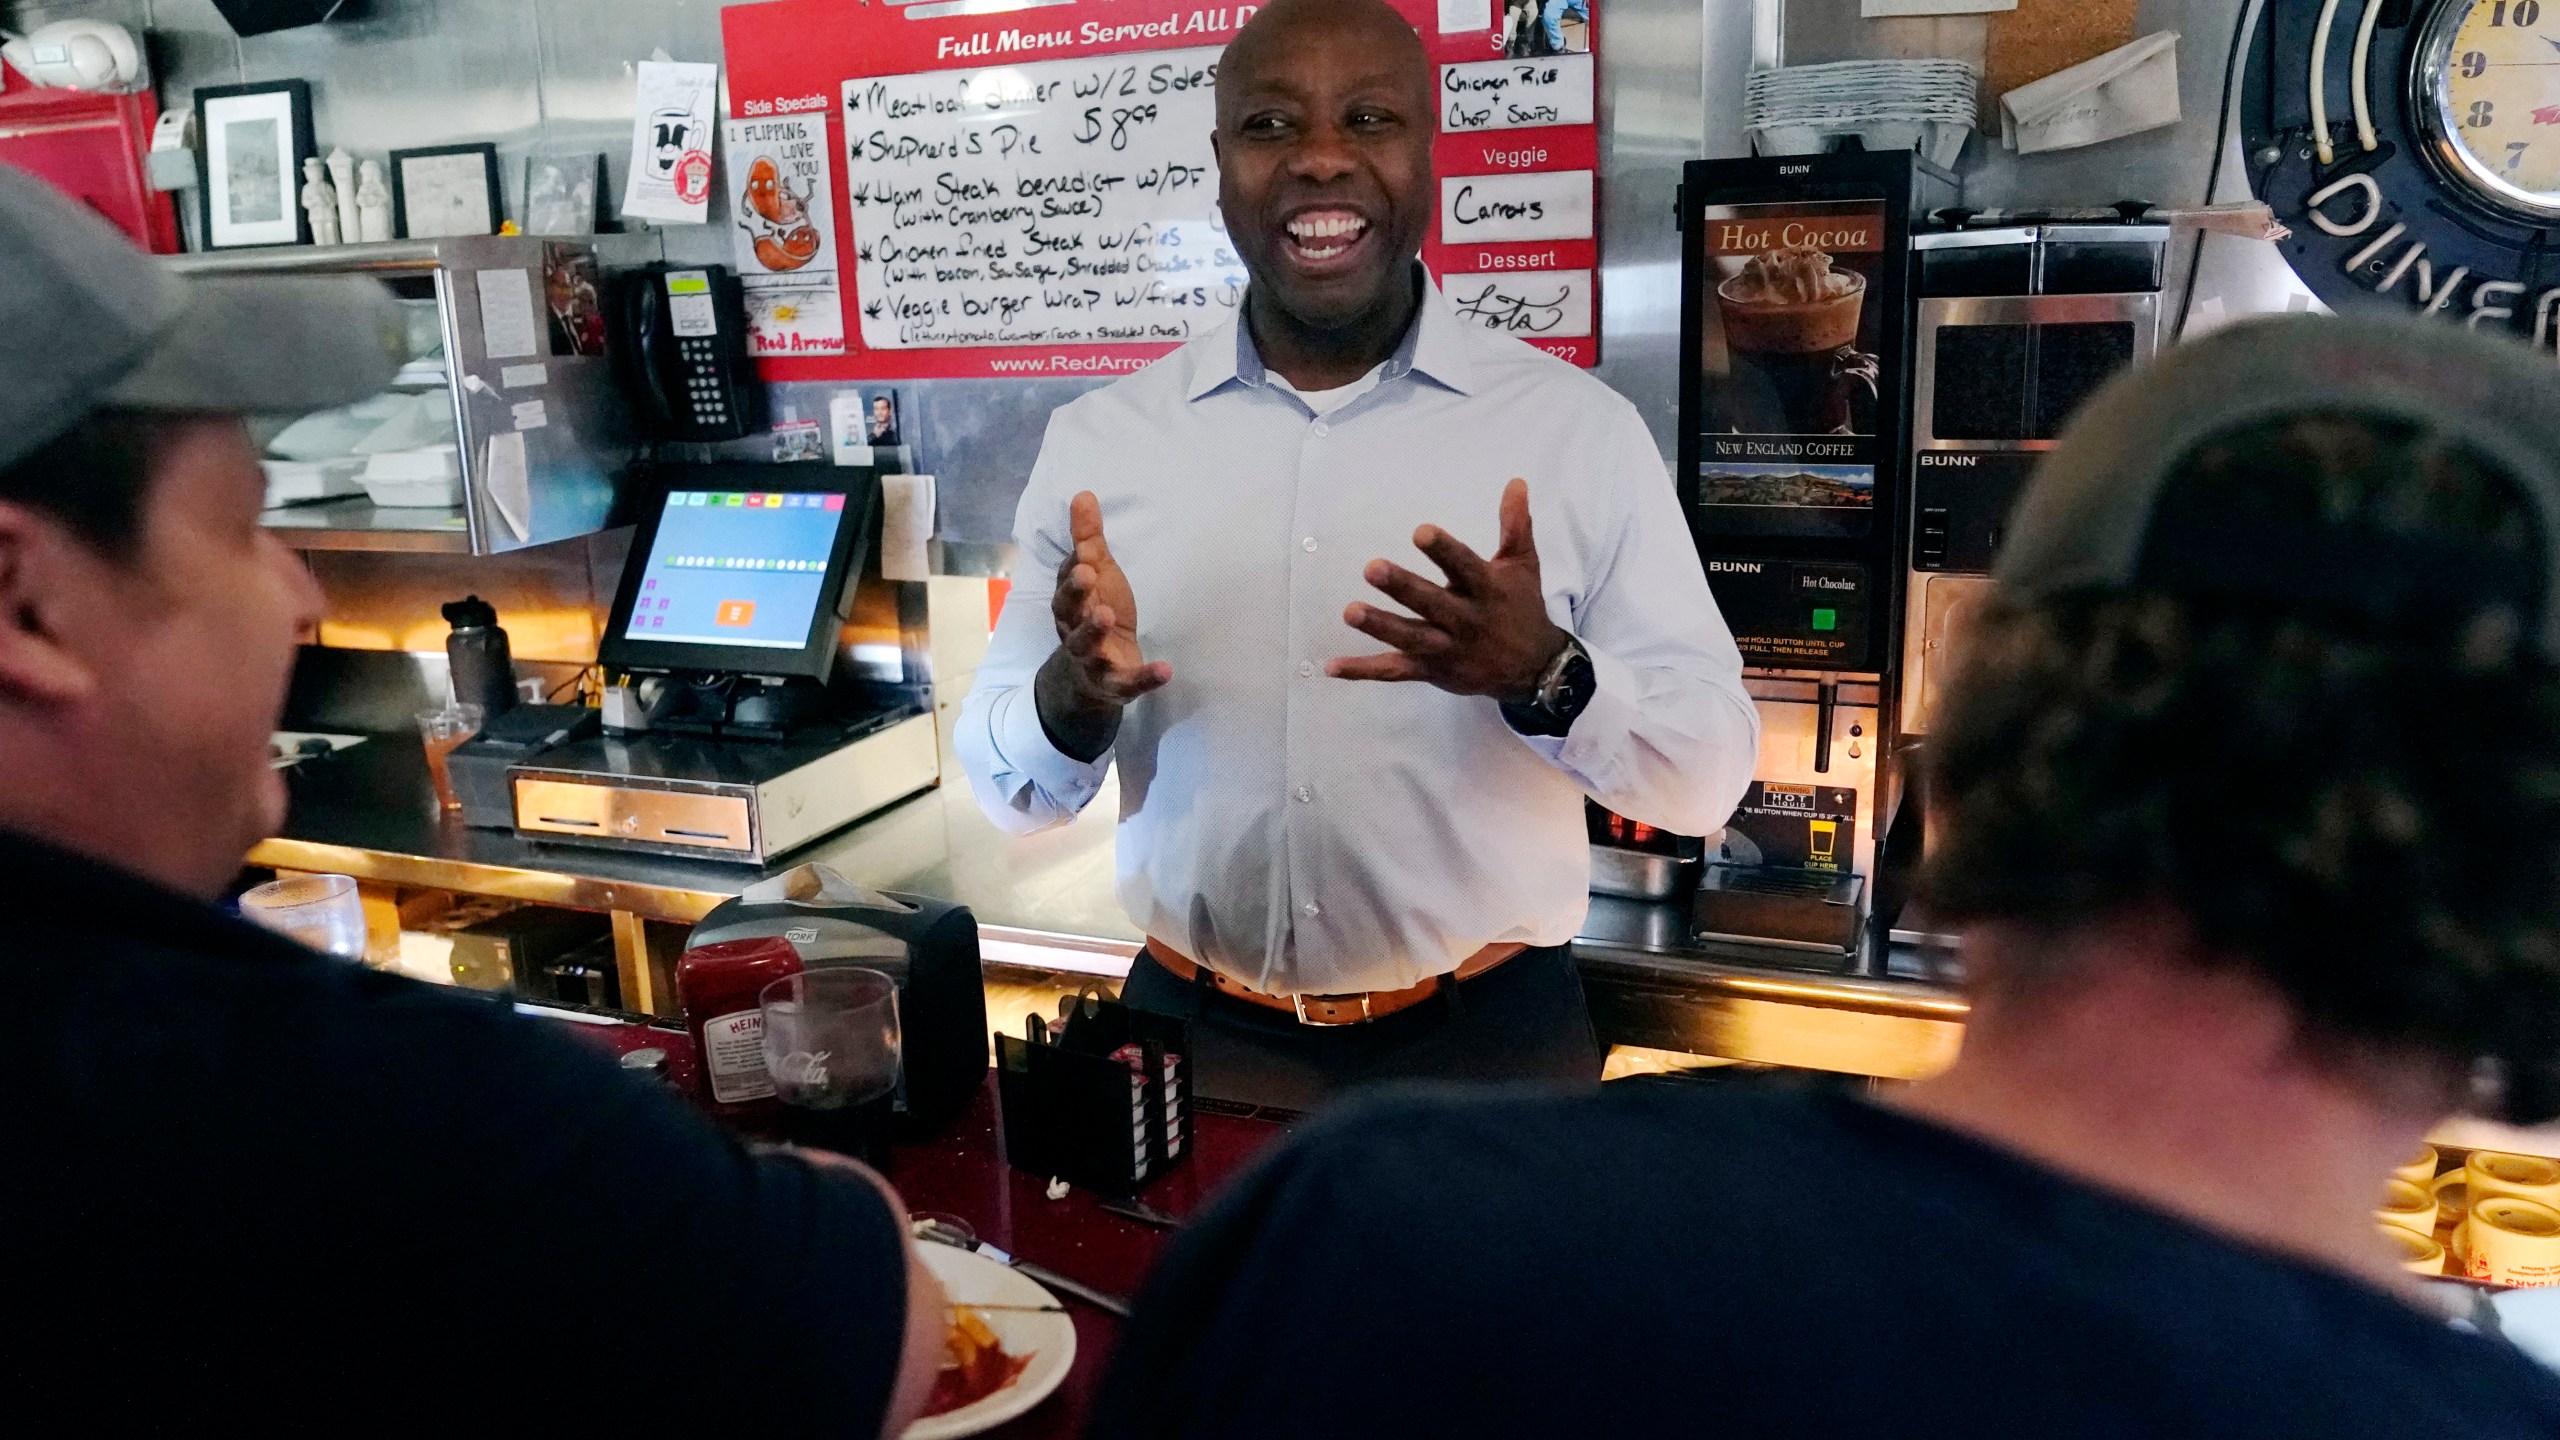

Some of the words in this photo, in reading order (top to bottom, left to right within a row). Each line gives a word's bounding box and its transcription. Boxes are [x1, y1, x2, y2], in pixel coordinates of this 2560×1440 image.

[2488, 0, 2539, 27] 10
[938, 33, 991, 59] Full
[996, 28, 1073, 52] Menu
[1080, 15, 1179, 45] Served
[1184, 8, 1228, 36] All
[2461, 51, 2487, 79] 9
[744, 99, 772, 116] Side
[775, 92, 829, 113] Specials
[2467, 100, 2493, 128] 8
[730, 128, 737, 142] I
[745, 122, 807, 142] FLIPPING
[780, 142, 815, 159] LOVE
[991, 124, 1042, 160] Pie
[1483, 147, 1548, 168] Veggie
[2505, 142, 2530, 169] 7
[793, 160, 819, 177] YOU
[1779, 164, 1811, 175] BUNN
[935, 172, 1000, 206] Steak
[1016, 169, 1125, 198] benedict
[1454, 185, 1544, 225] Carrots
[1720, 224, 1770, 250] Hot
[1782, 222, 1868, 249] Cocoa
[1479, 250, 1555, 269] Dessert
[887, 294, 950, 329] Veggie
[756, 332, 787, 352] Red
[791, 331, 844, 352] Arrow
[1716, 441, 1743, 455] NEW
[1746, 441, 1803, 456] ENGLAND
[1806, 442, 1855, 456] COFFEE
[1921, 455, 1977, 467] BUNN
[1709, 561, 1762, 574] BUNN
[1802, 575, 1817, 589] Hot
[1818, 576, 1856, 591] Chocolate
[1751, 636, 1772, 645] HOLD
[1773, 637, 1804, 646] BUTTON
[1805, 639, 1827, 648] UNTIL
[1828, 641, 1845, 649] CUP
[1772, 646, 1792, 655] THEN
[1793, 647, 1829, 657] RELEASE
[1772, 794, 1807, 802] HOT
[1754, 807, 1781, 816] BUTTON
[1782, 809, 1803, 818] WHEN
[1803, 811, 1818, 819] CUP
[1810, 854, 1832, 862] PLACE
[788, 932, 815, 940] TORK
[730, 1016, 762, 1034] HEIN
